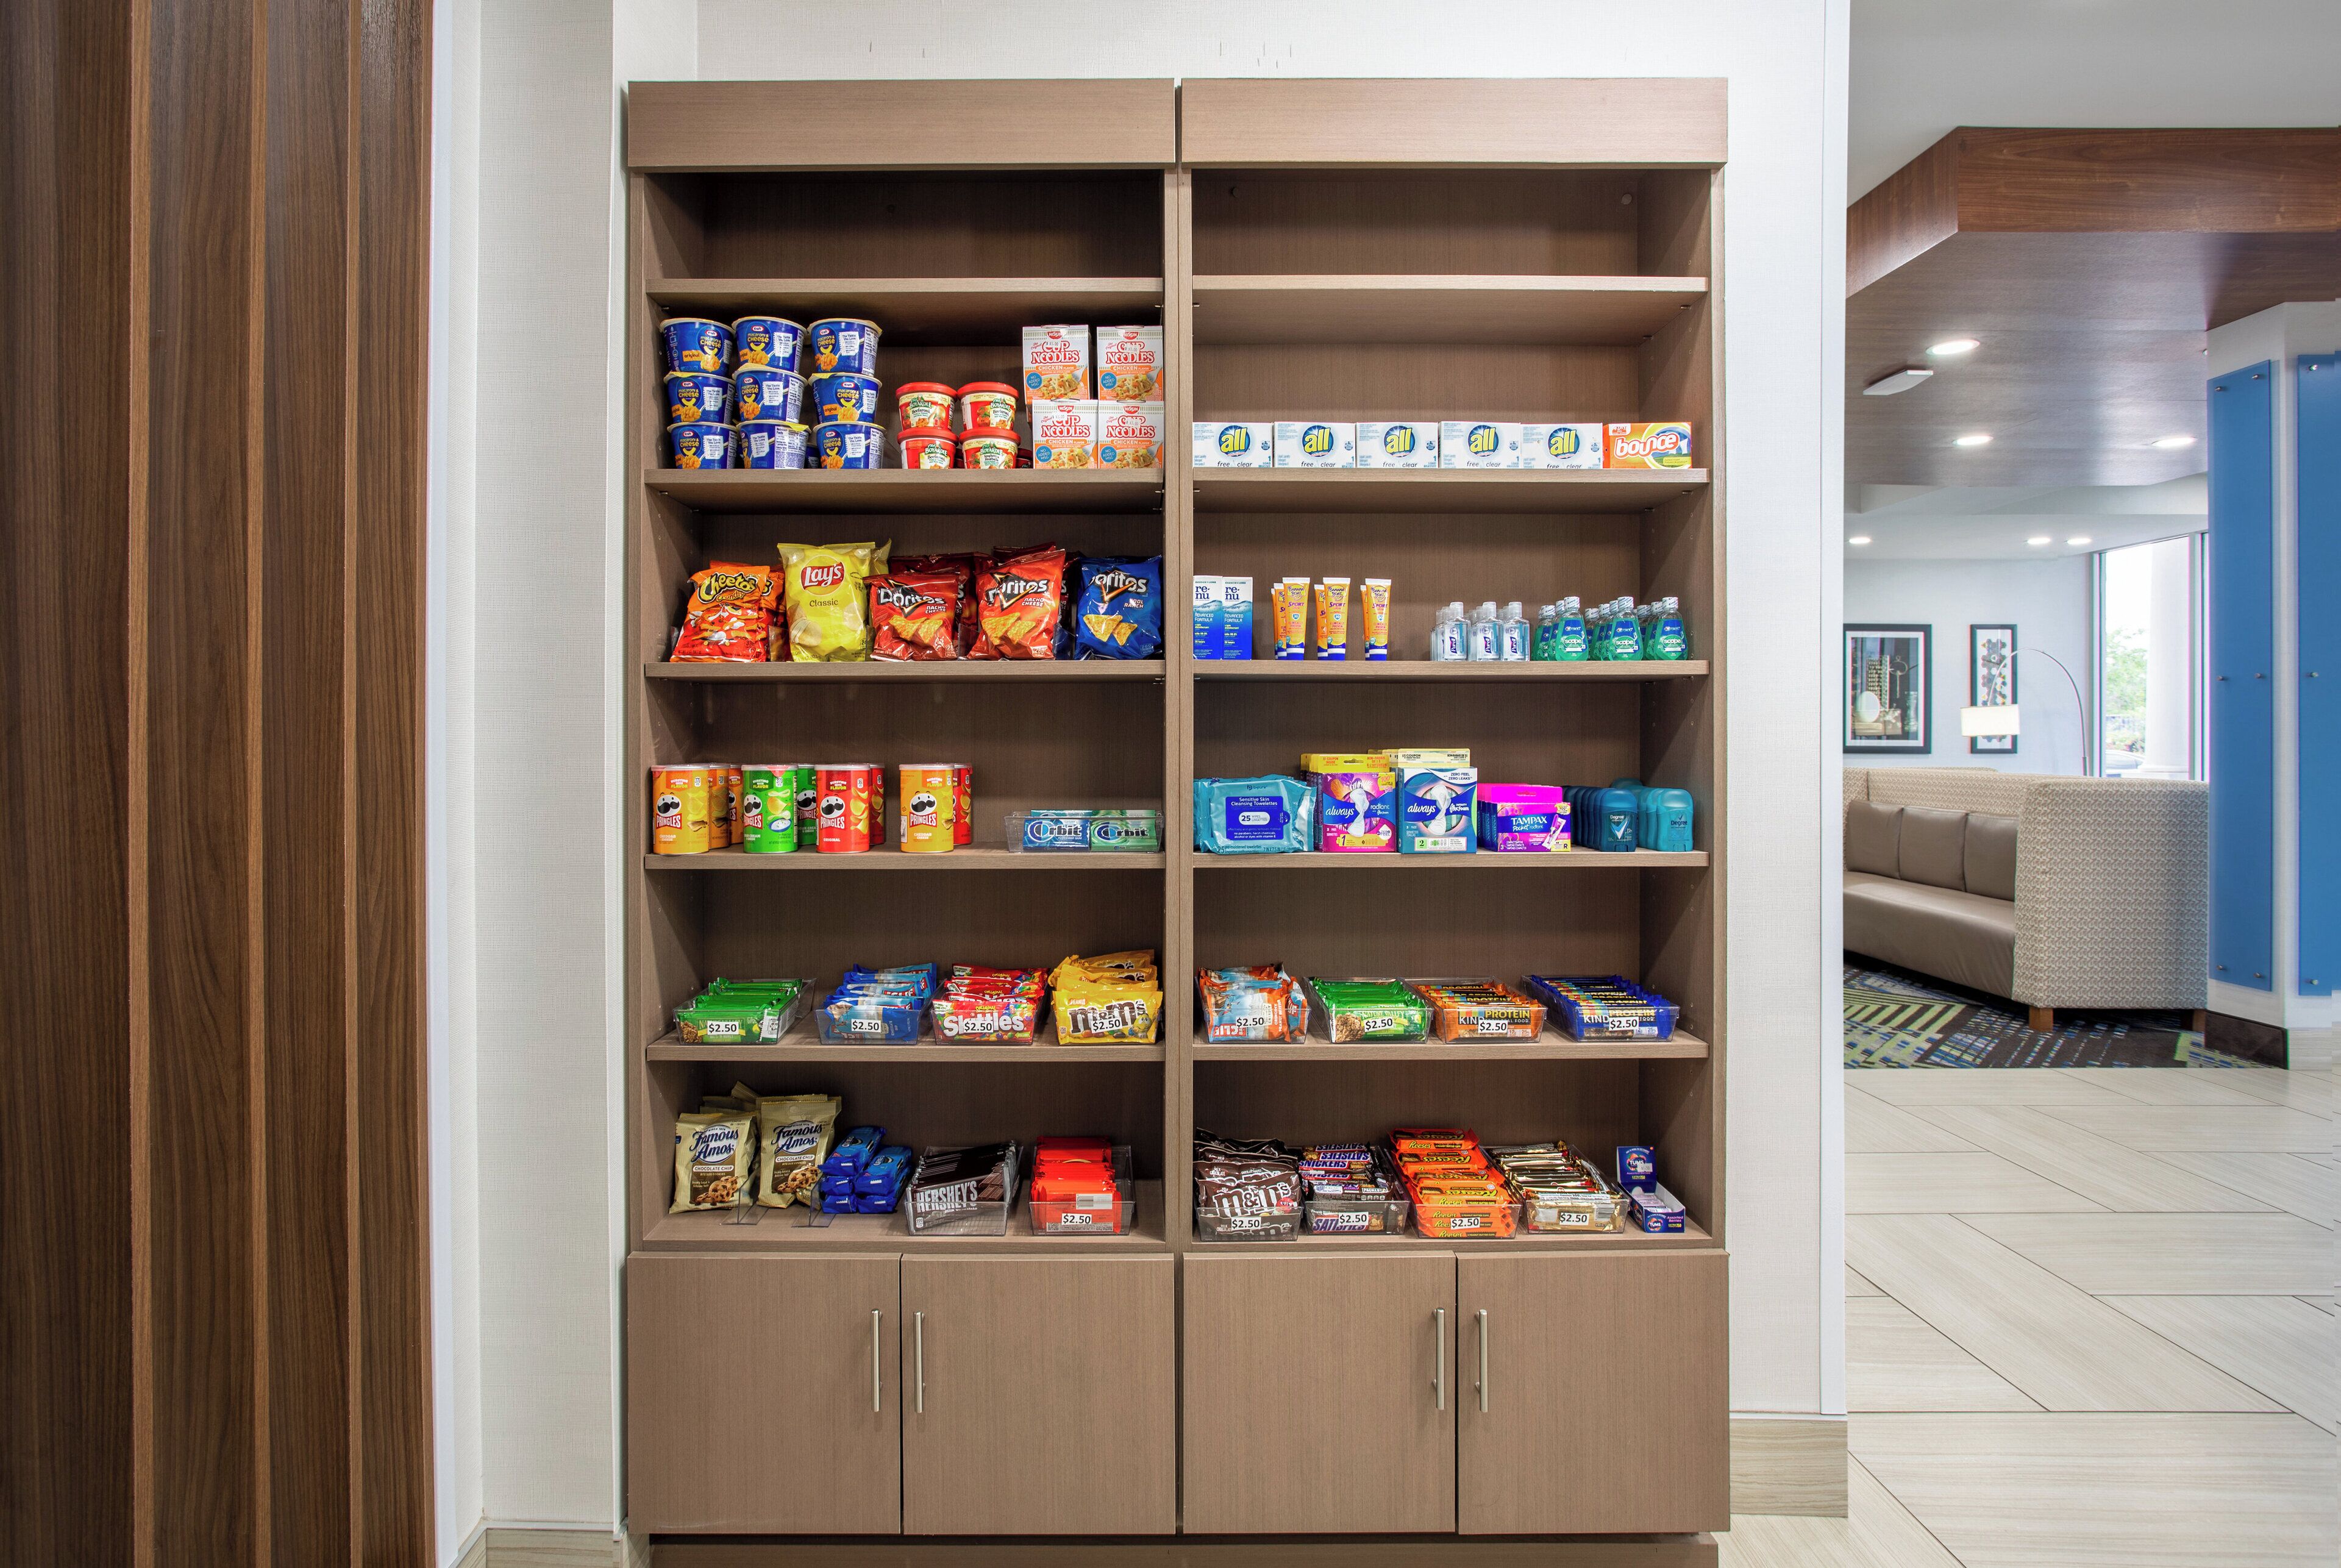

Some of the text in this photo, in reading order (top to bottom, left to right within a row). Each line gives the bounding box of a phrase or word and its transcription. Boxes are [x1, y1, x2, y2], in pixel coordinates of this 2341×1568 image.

[1031, 351, 1080, 364] NOODLES
[1106, 351, 1155, 364] NOODLES
[1041, 425, 1091, 438] NOODLES
[1106, 426, 1155, 438] NOODLES
[1220, 427, 1248, 454] all
[1303, 427, 1331, 454] all
[1386, 427, 1413, 454] all
[1469, 427, 1496, 454] all
[1549, 429, 1577, 456] all
[1615, 433, 1679, 458] bounce
[804, 564, 842, 587] Lay's
[699, 572, 757, 602] Cheetos
[716, 591, 745, 602] Crunchy
[810, 599, 838, 607] Classic
[878, 588, 945, 607] Doritos
[1326, 806, 1355, 819] always
[1408, 803, 1436, 816] always
[657, 814, 681, 829] PRINGLES
[821, 816, 844, 829] PRINGLES
[910, 813, 936, 826] PRINGLES
[1511, 816, 1547, 825] TAMPAX
[1028, 820, 1082, 842] Orbit
[1097, 822, 1149, 841] Orbit
[1342, 835, 1346, 846] 1
[709, 1023, 736, 1033] $2.50
[852, 1021, 879, 1031] $2.50
[964, 1023, 992, 1032] $2.50
[1092, 1019, 1121, 1032] $2.50
[1236, 1017, 1264, 1028] $2.50
[1366, 1018, 1393, 1031] $2.50
[1480, 1022, 1507, 1032] $2.50
[1610, 1020, 1637, 1029] $2.50
[1213, 1025, 1238, 1035] CLIF
[689, 1129, 739, 1151] Famous
[771, 1124, 822, 1145] Famous
[774, 1136, 818, 1154] Amos
[691, 1143, 735, 1162] Amos
[916, 1180, 978, 1213] HERSHEY'S
[1063, 1214, 1091, 1224] $2.50
[1232, 1219, 1260, 1229] $2.50
[1340, 1214, 1367, 1224] $2.50
[1452, 1218, 1479, 1228] $2.50
[1560, 1213, 1587, 1222] $2.50
